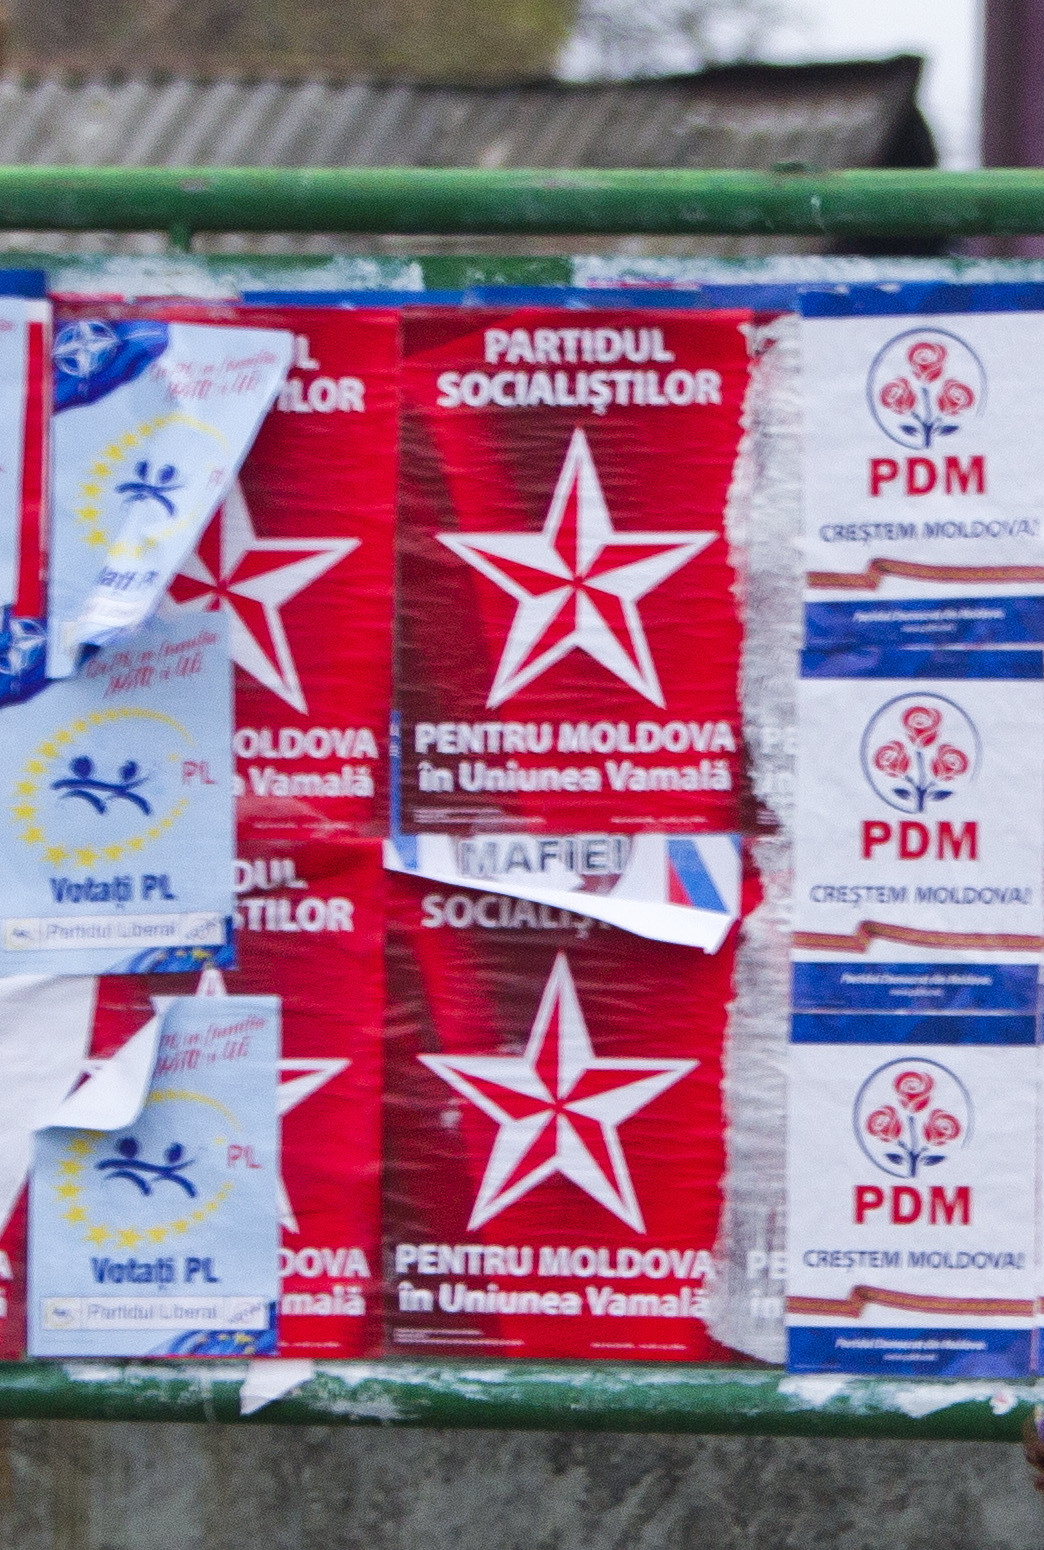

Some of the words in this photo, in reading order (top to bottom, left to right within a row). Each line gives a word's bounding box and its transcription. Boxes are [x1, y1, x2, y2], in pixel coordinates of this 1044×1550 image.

[486, 329, 673, 362] PARTIDUL
[438, 371, 720, 413] SOCIALIȘTILOR
[870, 455, 985, 496] PDM
[924, 519, 1038, 538] MOLDOVA!
[234, 728, 377, 758] OLDOVA
[415, 722, 552, 755] PENTRU
[558, 722, 735, 762] MOLDOVA
[250, 766, 373, 798] Vamală
[459, 762, 600, 791] Uniunea
[606, 760, 731, 790] Vamală
[862, 820, 978, 860] PDM
[143, 874, 177, 900] PL
[916, 886, 1031, 905] MOLDOVA!
[855, 1185, 971, 1224] PDM
[90, 1256, 175, 1290] Votați
[185, 1257, 220, 1284] PL
[277, 1243, 369, 1281] DOVA
[395, 1244, 531, 1275] PENTRU
[533, 1248, 716, 1280] MOLDOVA
[908, 1251, 1025, 1269] MOLDOVA!
[280, 1287, 366, 1318] mală
[439, 1284, 581, 1314] Uniunea
[584, 1286, 708, 1318] Vamală
